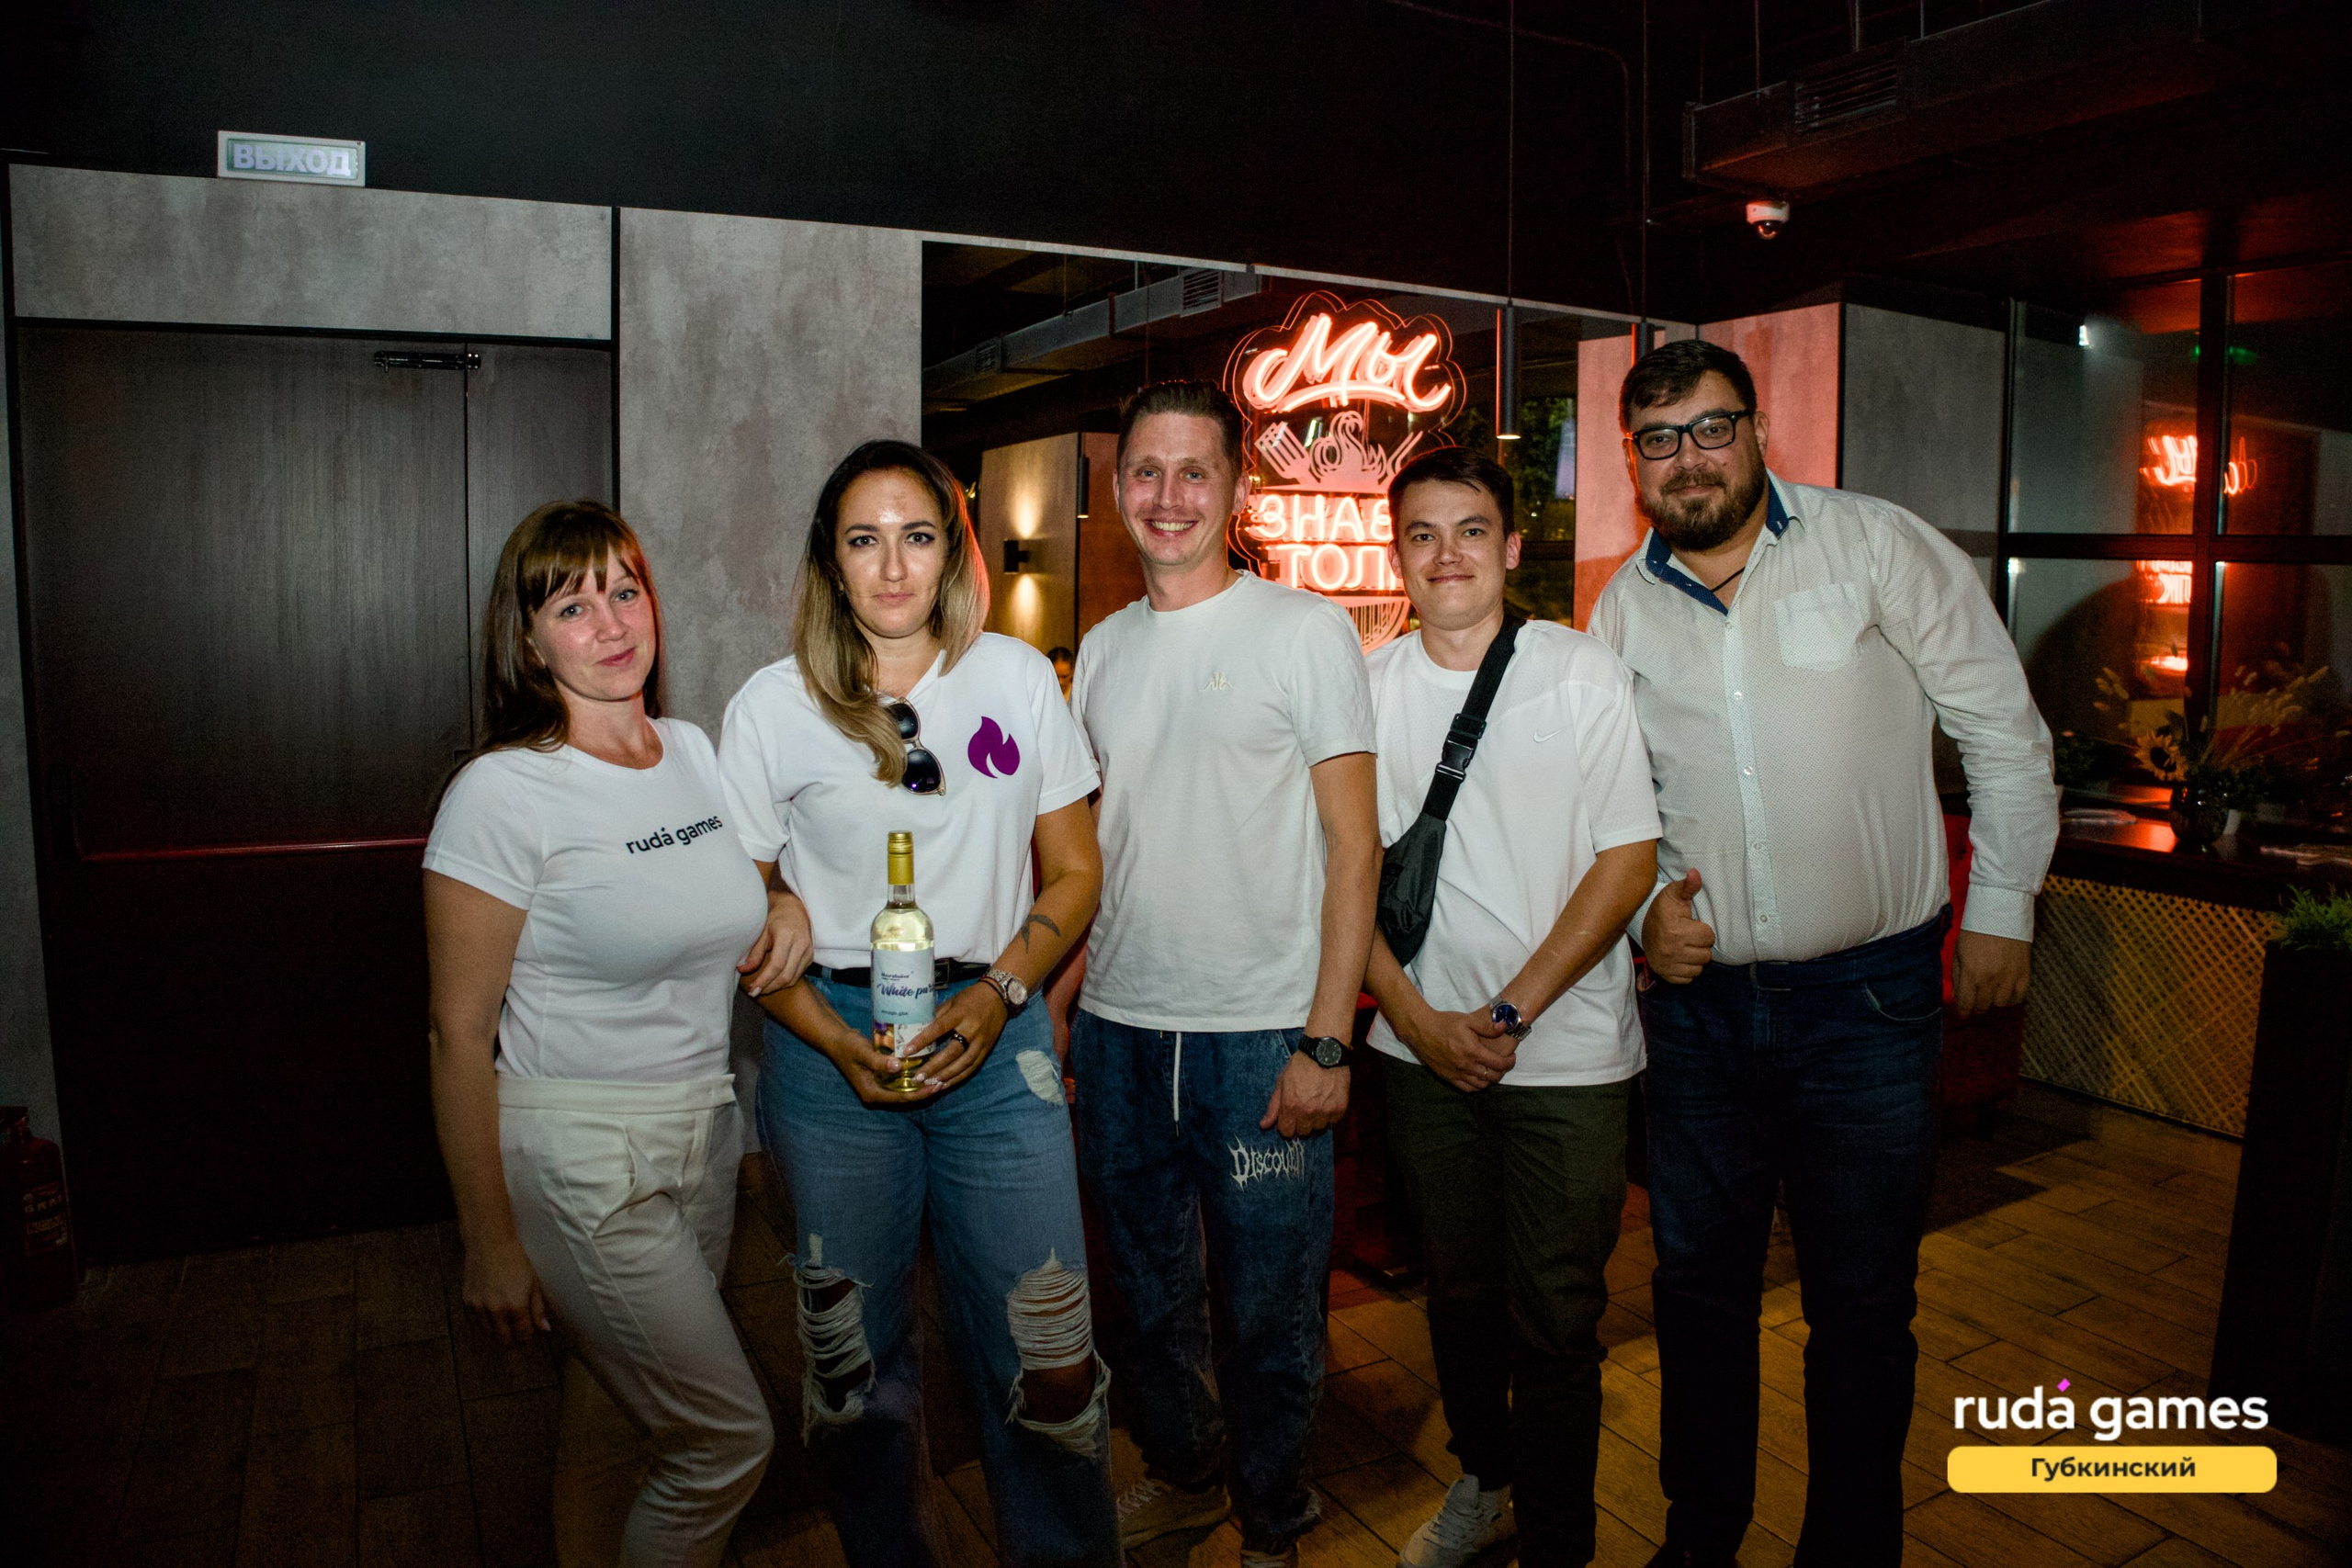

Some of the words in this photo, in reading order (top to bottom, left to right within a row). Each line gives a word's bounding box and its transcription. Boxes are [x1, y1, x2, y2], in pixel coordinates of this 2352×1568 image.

[233, 143, 351, 176] ВЫХОД
[1243, 312, 1452, 412] Мы
[1254, 493, 1395, 543] ЗНАЕ
[1276, 543, 1397, 591] ТОЛ
[676, 816, 723, 845] games
[876, 982, 914, 998] White
